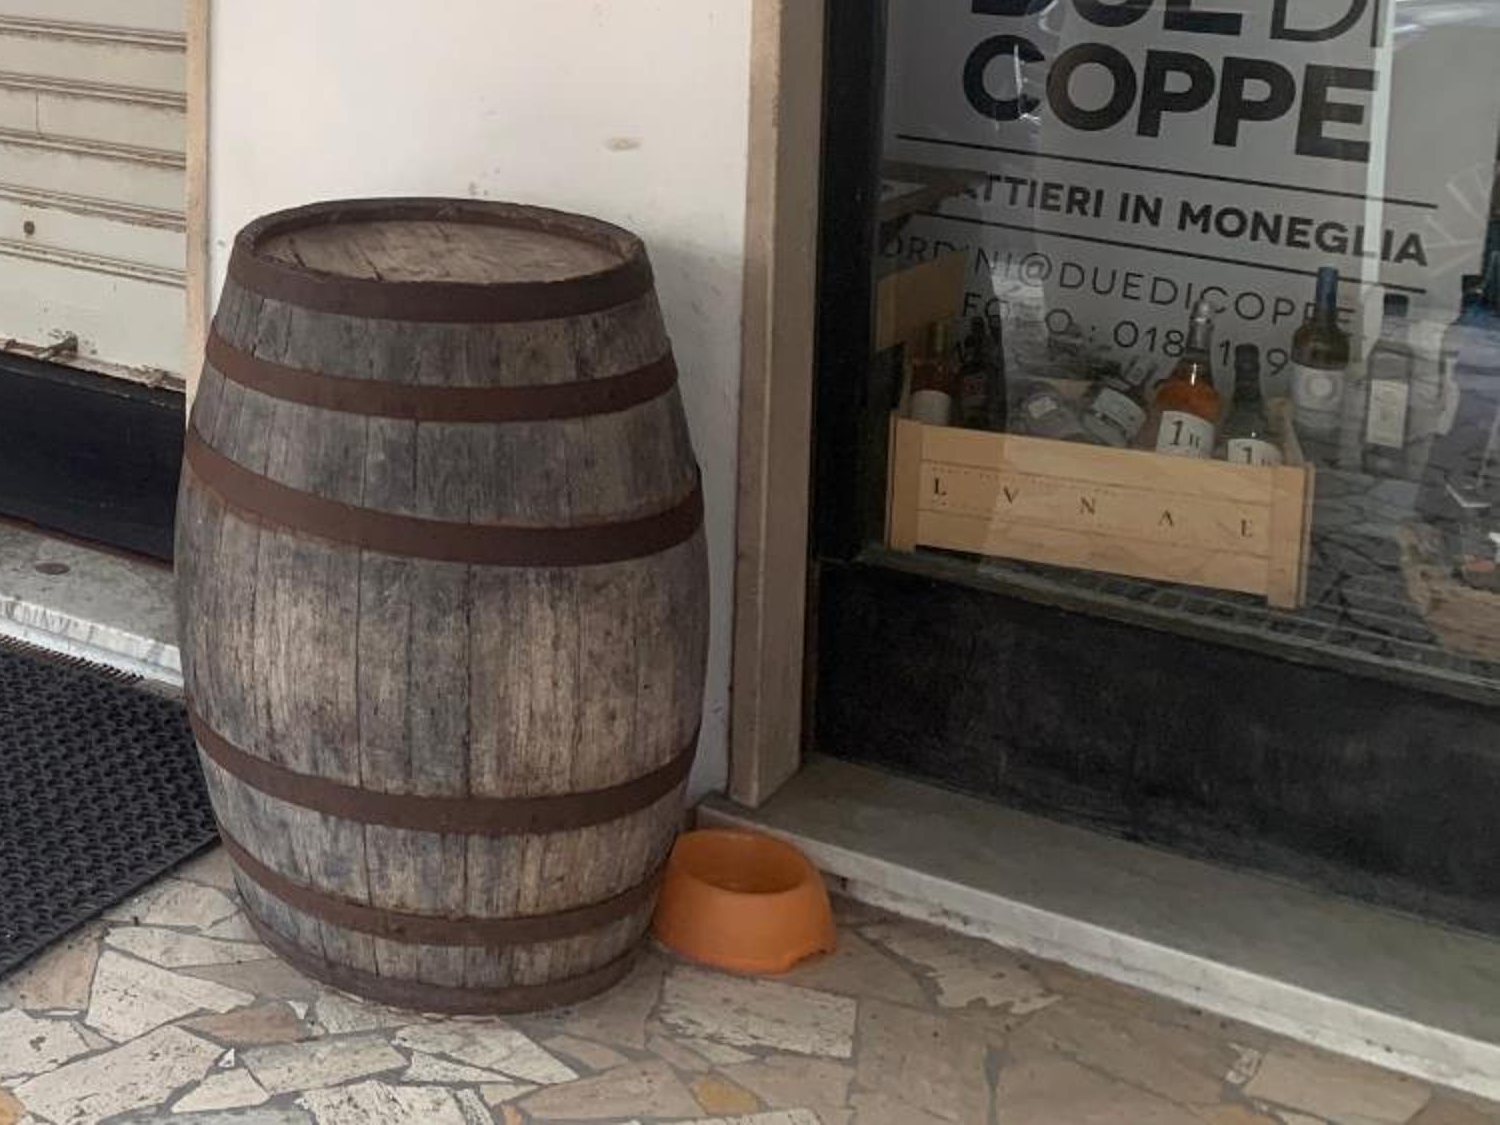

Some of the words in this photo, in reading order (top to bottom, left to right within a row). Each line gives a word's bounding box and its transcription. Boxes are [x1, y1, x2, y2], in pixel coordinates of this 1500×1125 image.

[961, 34, 1380, 163] COPPE
[1117, 196, 1162, 228] IN
[1176, 205, 1429, 267] MONEGLIA
